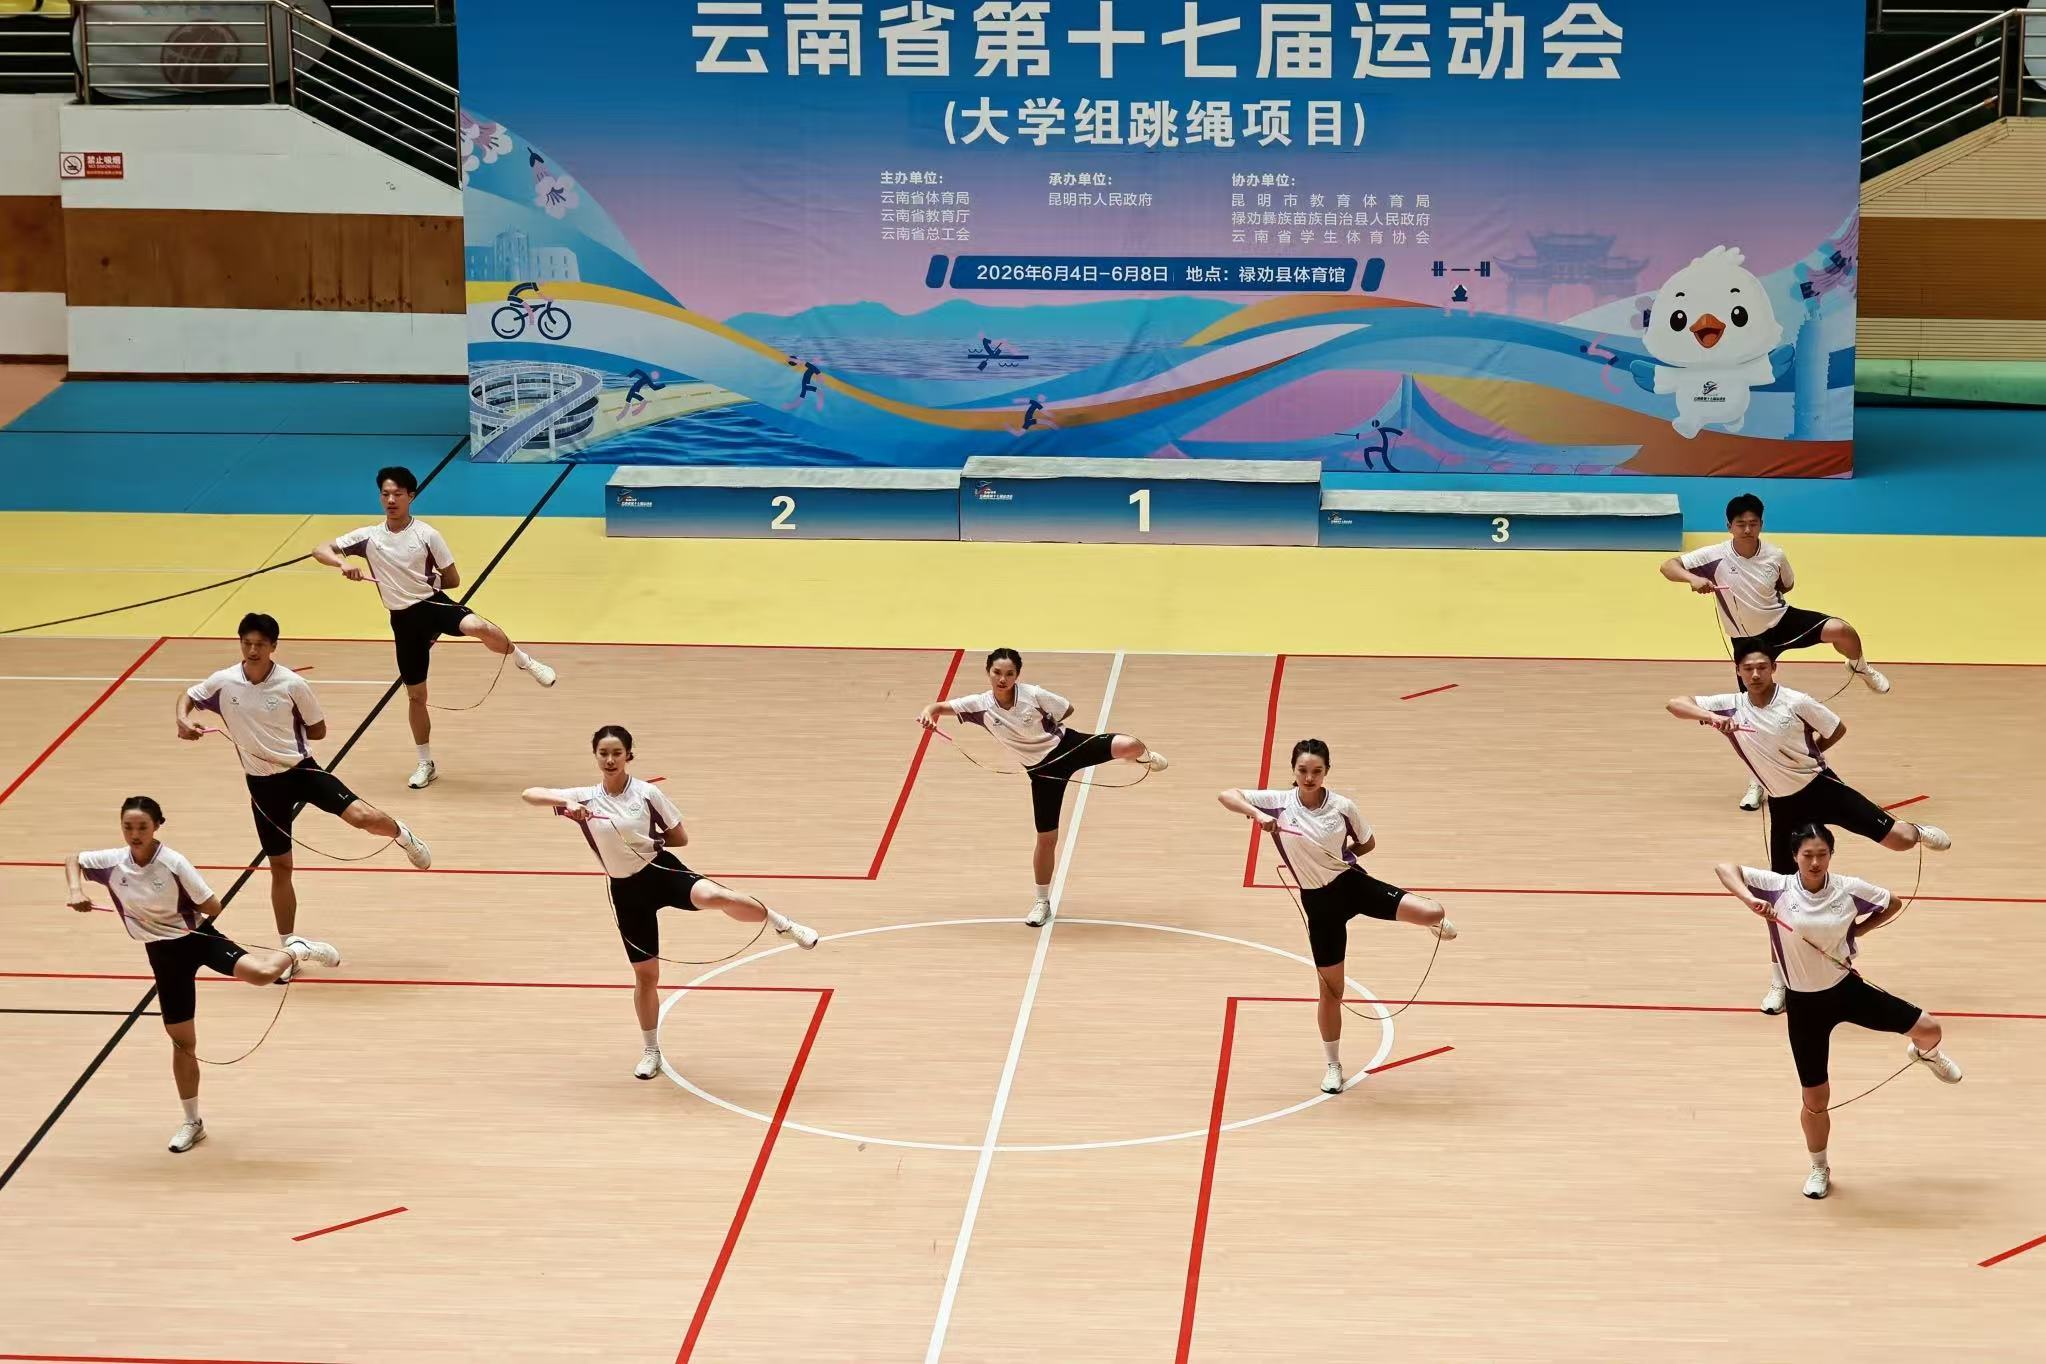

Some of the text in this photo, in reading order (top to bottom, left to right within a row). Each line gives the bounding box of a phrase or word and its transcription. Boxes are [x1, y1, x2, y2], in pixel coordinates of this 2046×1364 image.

[691, 0, 1624, 80] 云南省第十七届运动会
[880, 191, 970, 206] 云南省体育局
[1048, 192, 1153, 207] 昆明市人民政府
[1231, 193, 1431, 208] 昆明市教育体育局
[880, 209, 970, 223] 云南省教育厅
[1231, 211, 1431, 226] 禄劝彝族苗族自治县人民政府
[880, 227, 970, 241] 云南省总工会
[1231, 230, 1431, 245] 云南省学生体育协会
[771, 495, 796, 530] 2
[1129, 489, 1150, 532] 1
[1491, 516, 1510, 543] 3
